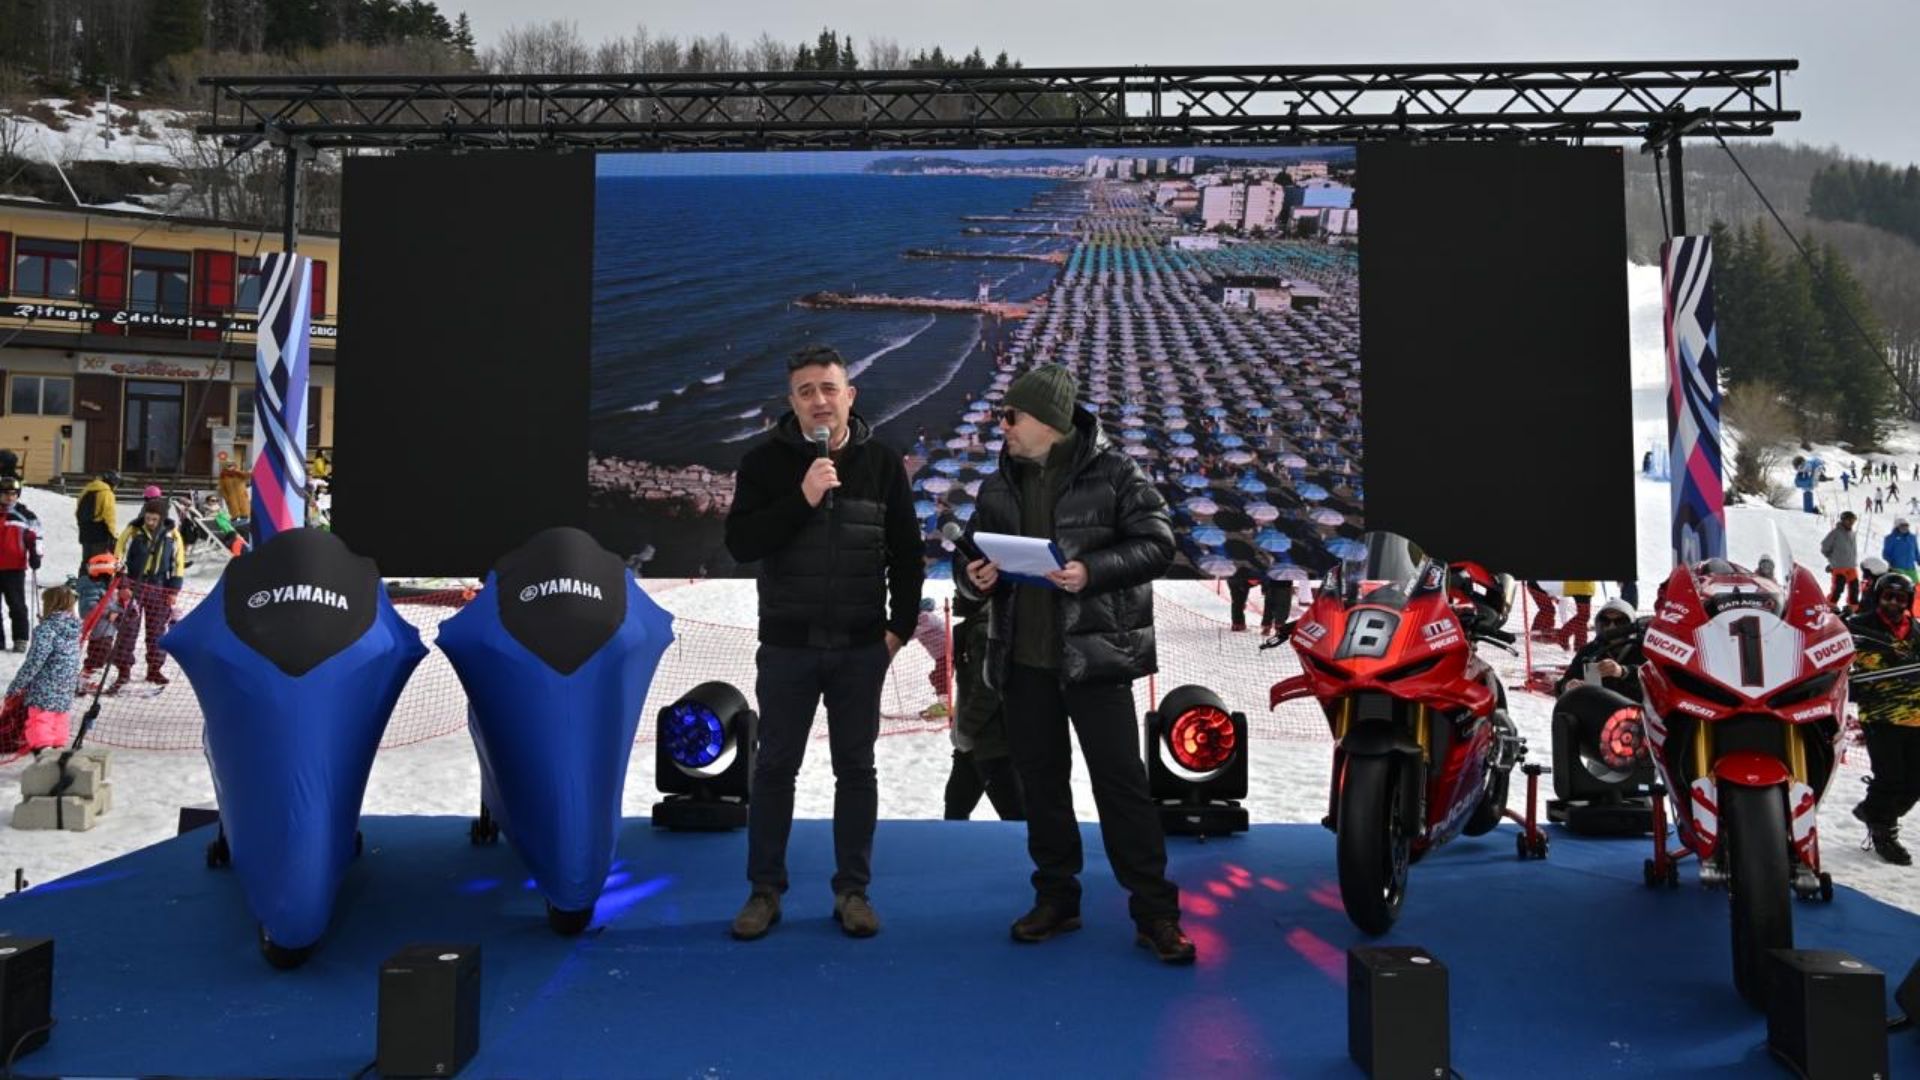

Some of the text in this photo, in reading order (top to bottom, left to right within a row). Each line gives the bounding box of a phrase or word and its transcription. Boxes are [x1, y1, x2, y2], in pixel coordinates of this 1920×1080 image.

[14, 304, 100, 320] Rifugio
[112, 311, 217, 328] Edelweiss
[273, 585, 348, 610] YAMAHA
[539, 578, 602, 600] YAMAHA
[1646, 633, 1688, 658] DUCATI
[1729, 615, 1764, 688] 1
[1813, 637, 1850, 662] DUCATI
[1677, 701, 1716, 718] DUCATI
